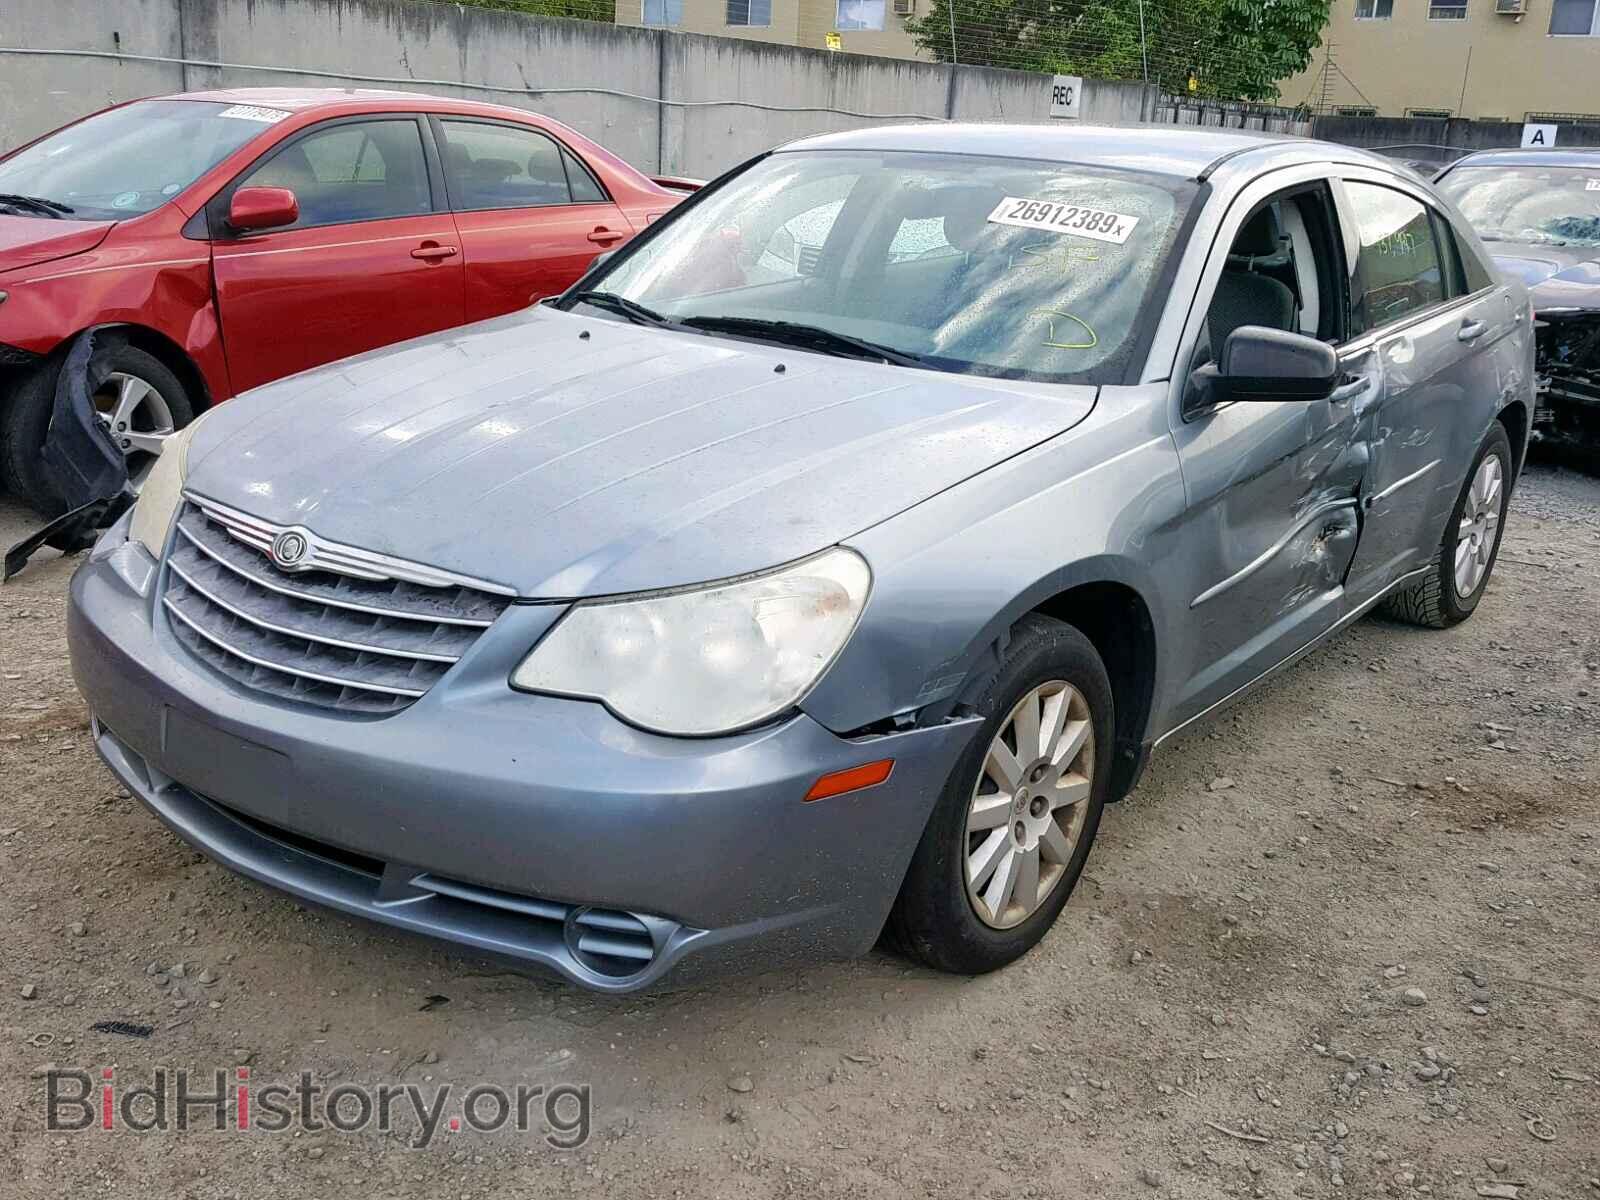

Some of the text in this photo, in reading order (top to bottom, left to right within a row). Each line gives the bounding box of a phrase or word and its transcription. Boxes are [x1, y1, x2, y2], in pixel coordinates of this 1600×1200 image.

[1052, 85, 1073, 106] REC
[1530, 128, 1545, 145] A
[1028, 308, 1097, 349] D
